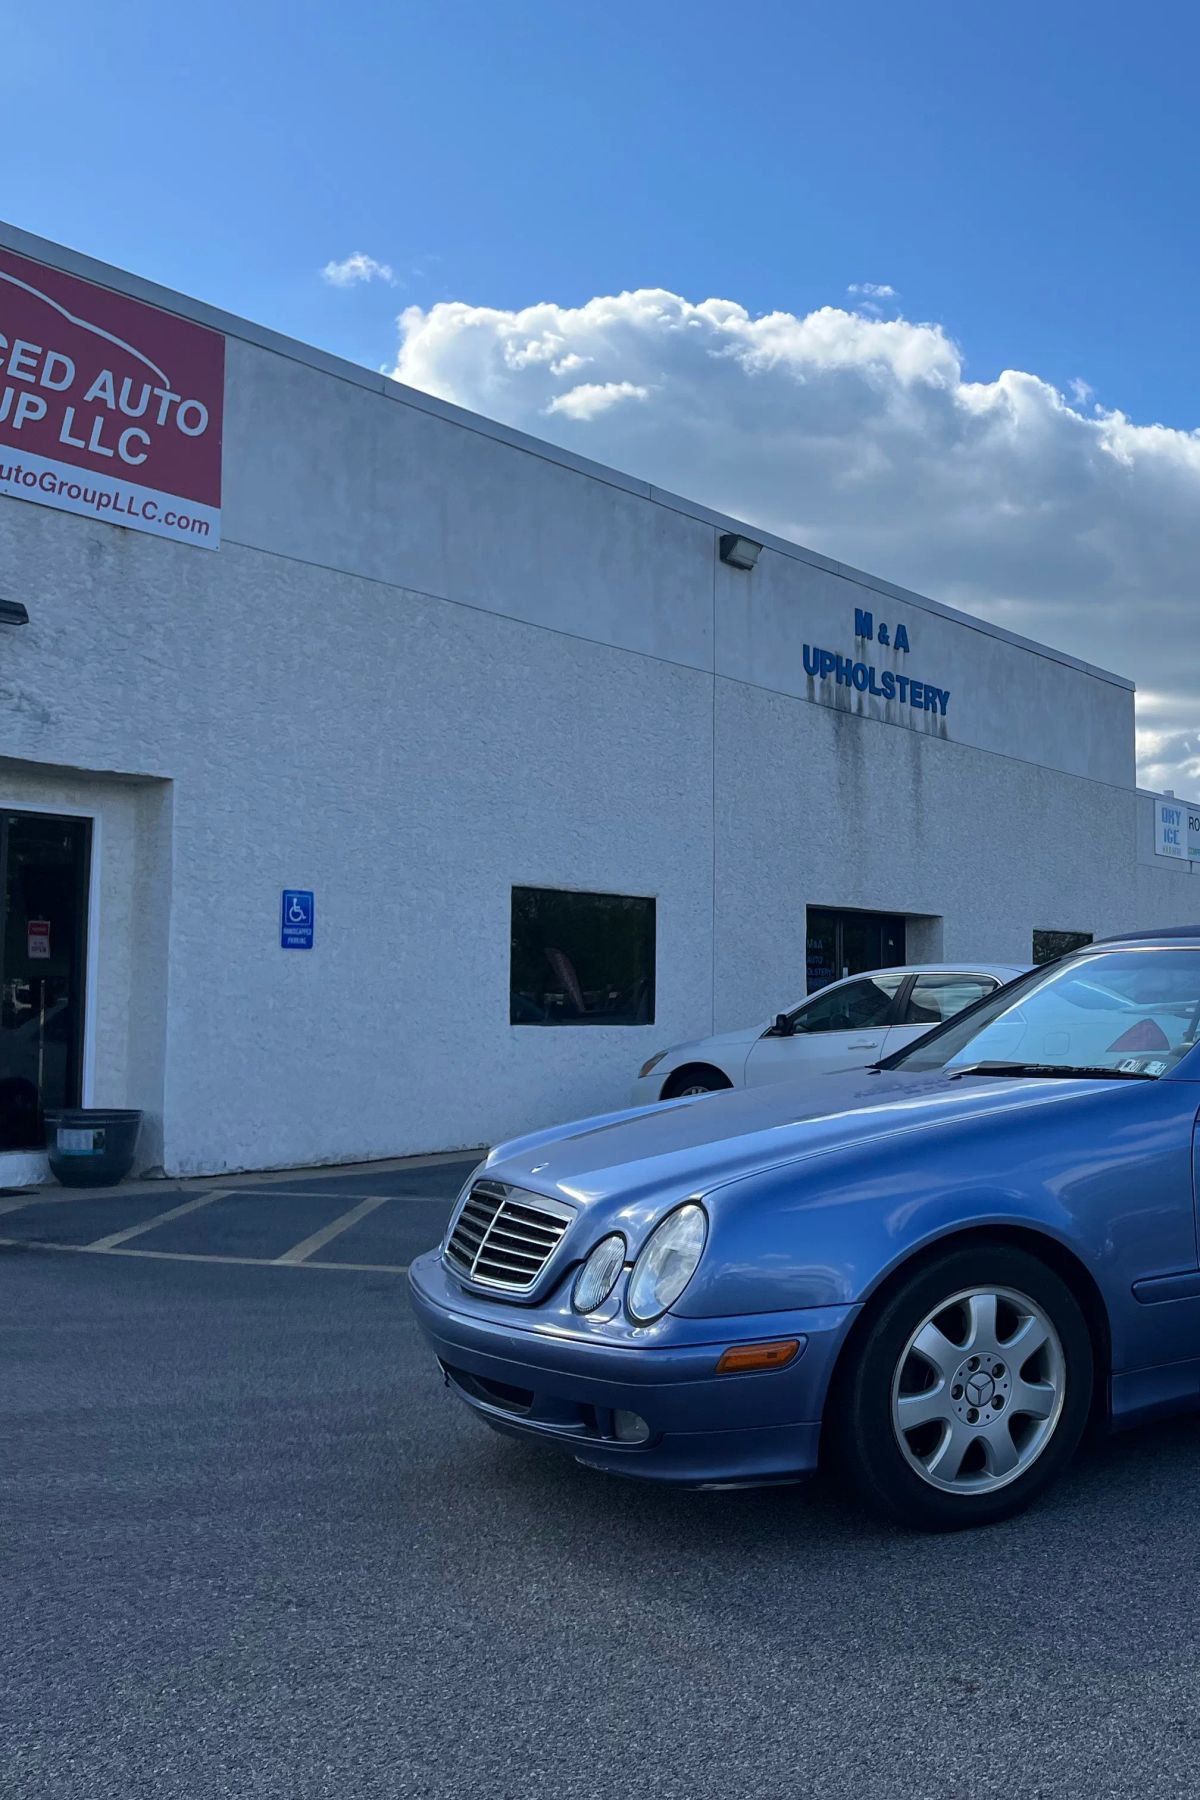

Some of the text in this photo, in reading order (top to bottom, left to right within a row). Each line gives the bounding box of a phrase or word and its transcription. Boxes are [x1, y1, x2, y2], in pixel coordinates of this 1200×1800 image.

[0, 333, 209, 436] ED AUTO
[59, 406, 151, 465] LLC
[854, 607, 910, 653] M & A
[802, 643, 950, 716] UPHOLSTERY
[1161, 807, 1182, 826] DRY
[1163, 827, 1181, 845] ICE
